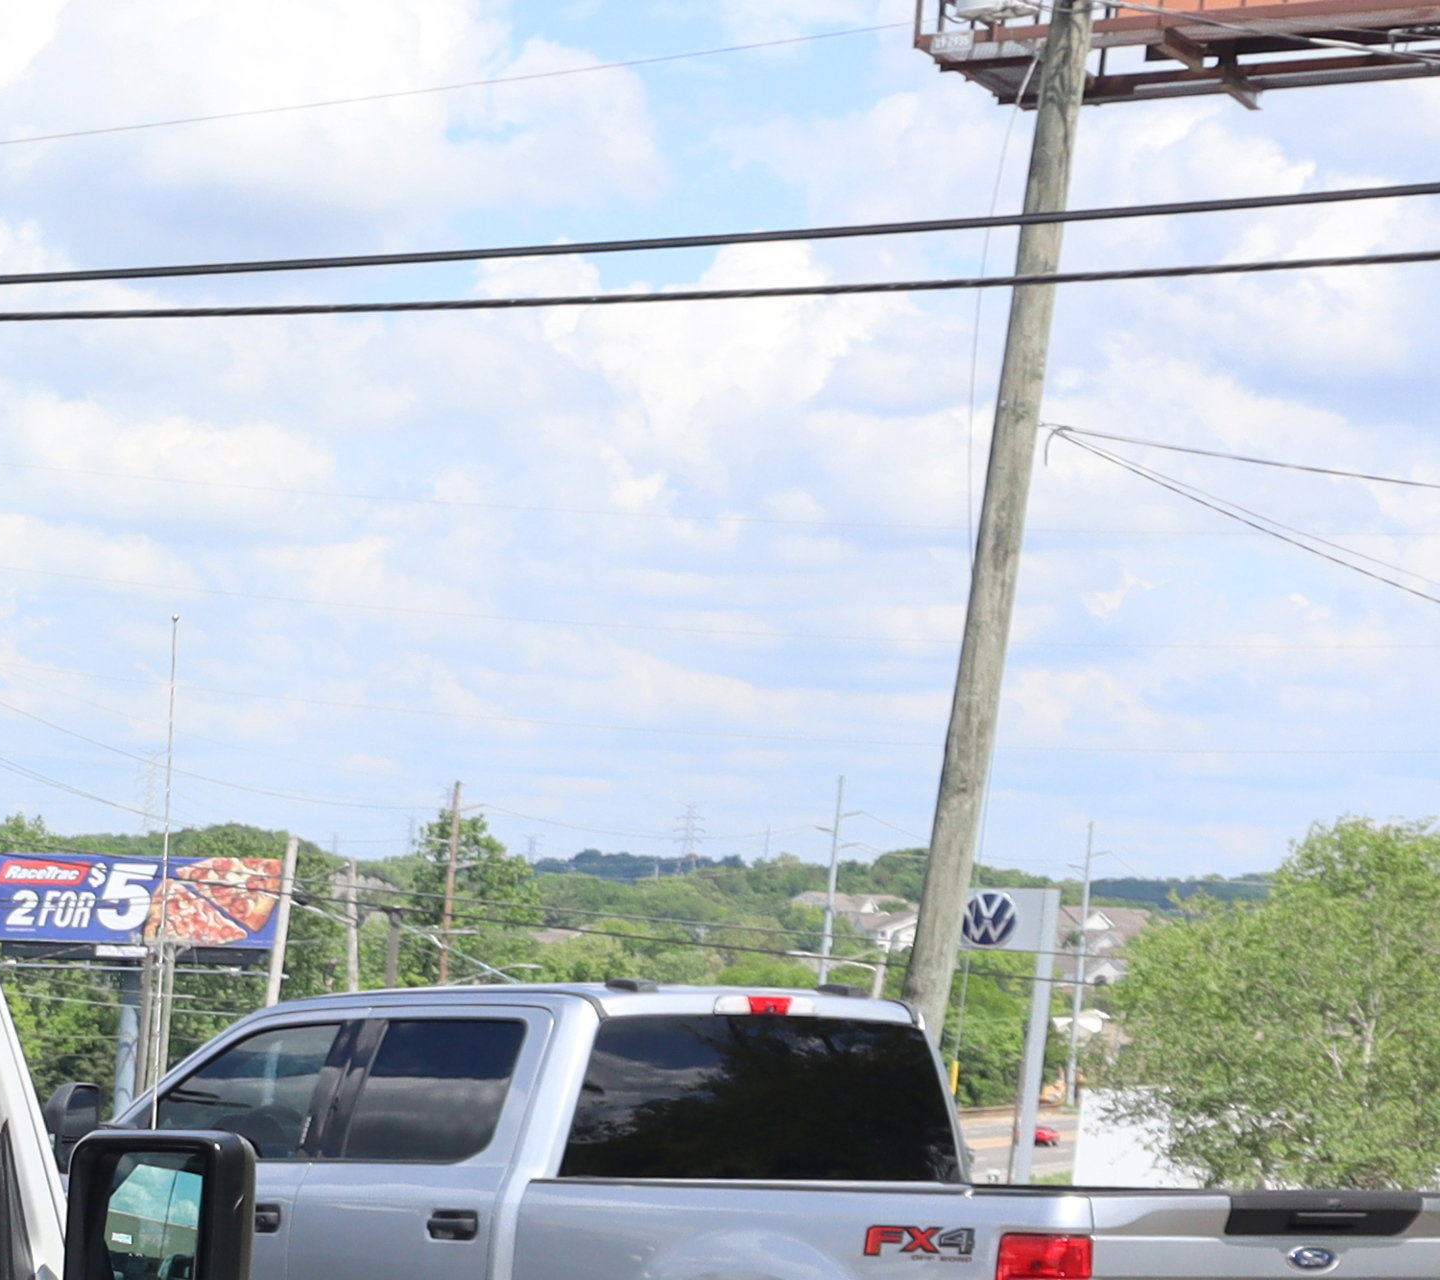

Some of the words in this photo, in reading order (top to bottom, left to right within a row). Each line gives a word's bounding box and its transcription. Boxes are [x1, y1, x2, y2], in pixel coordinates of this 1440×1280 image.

[4, 864, 80, 881] RaceTrac
[6, 888, 39, 926] 2
[37, 889, 97, 929] FOR
[863, 1225, 975, 1256] FX4
